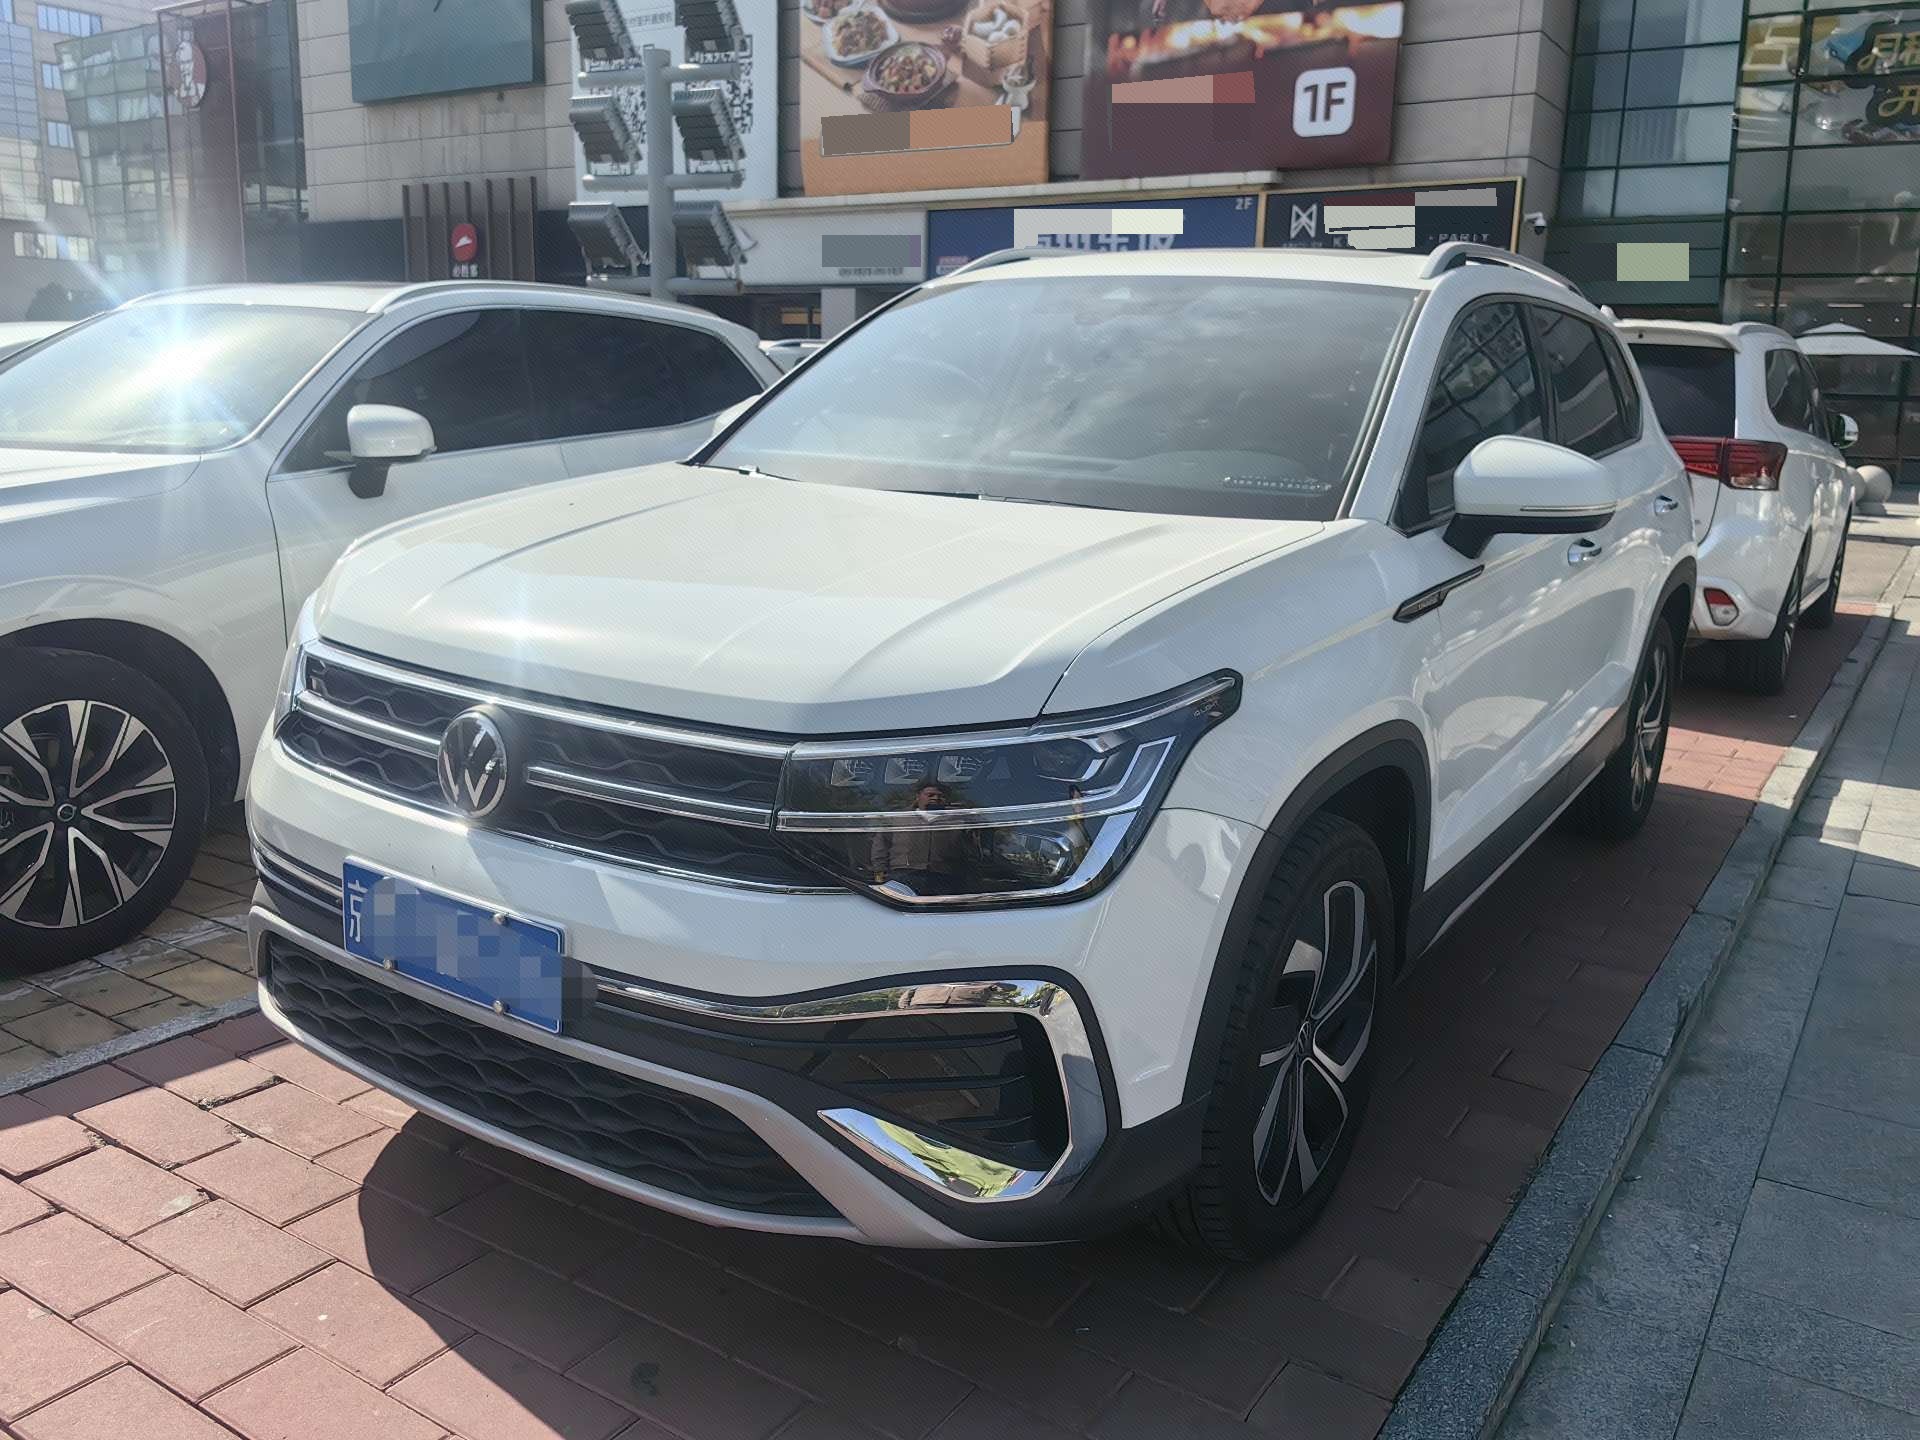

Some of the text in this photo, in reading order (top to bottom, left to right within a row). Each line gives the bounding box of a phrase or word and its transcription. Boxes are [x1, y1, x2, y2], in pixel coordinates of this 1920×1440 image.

[1304, 82, 1347, 122] 1F
[1235, 198, 1253, 211] 2F
[347, 879, 369, 943] 京
